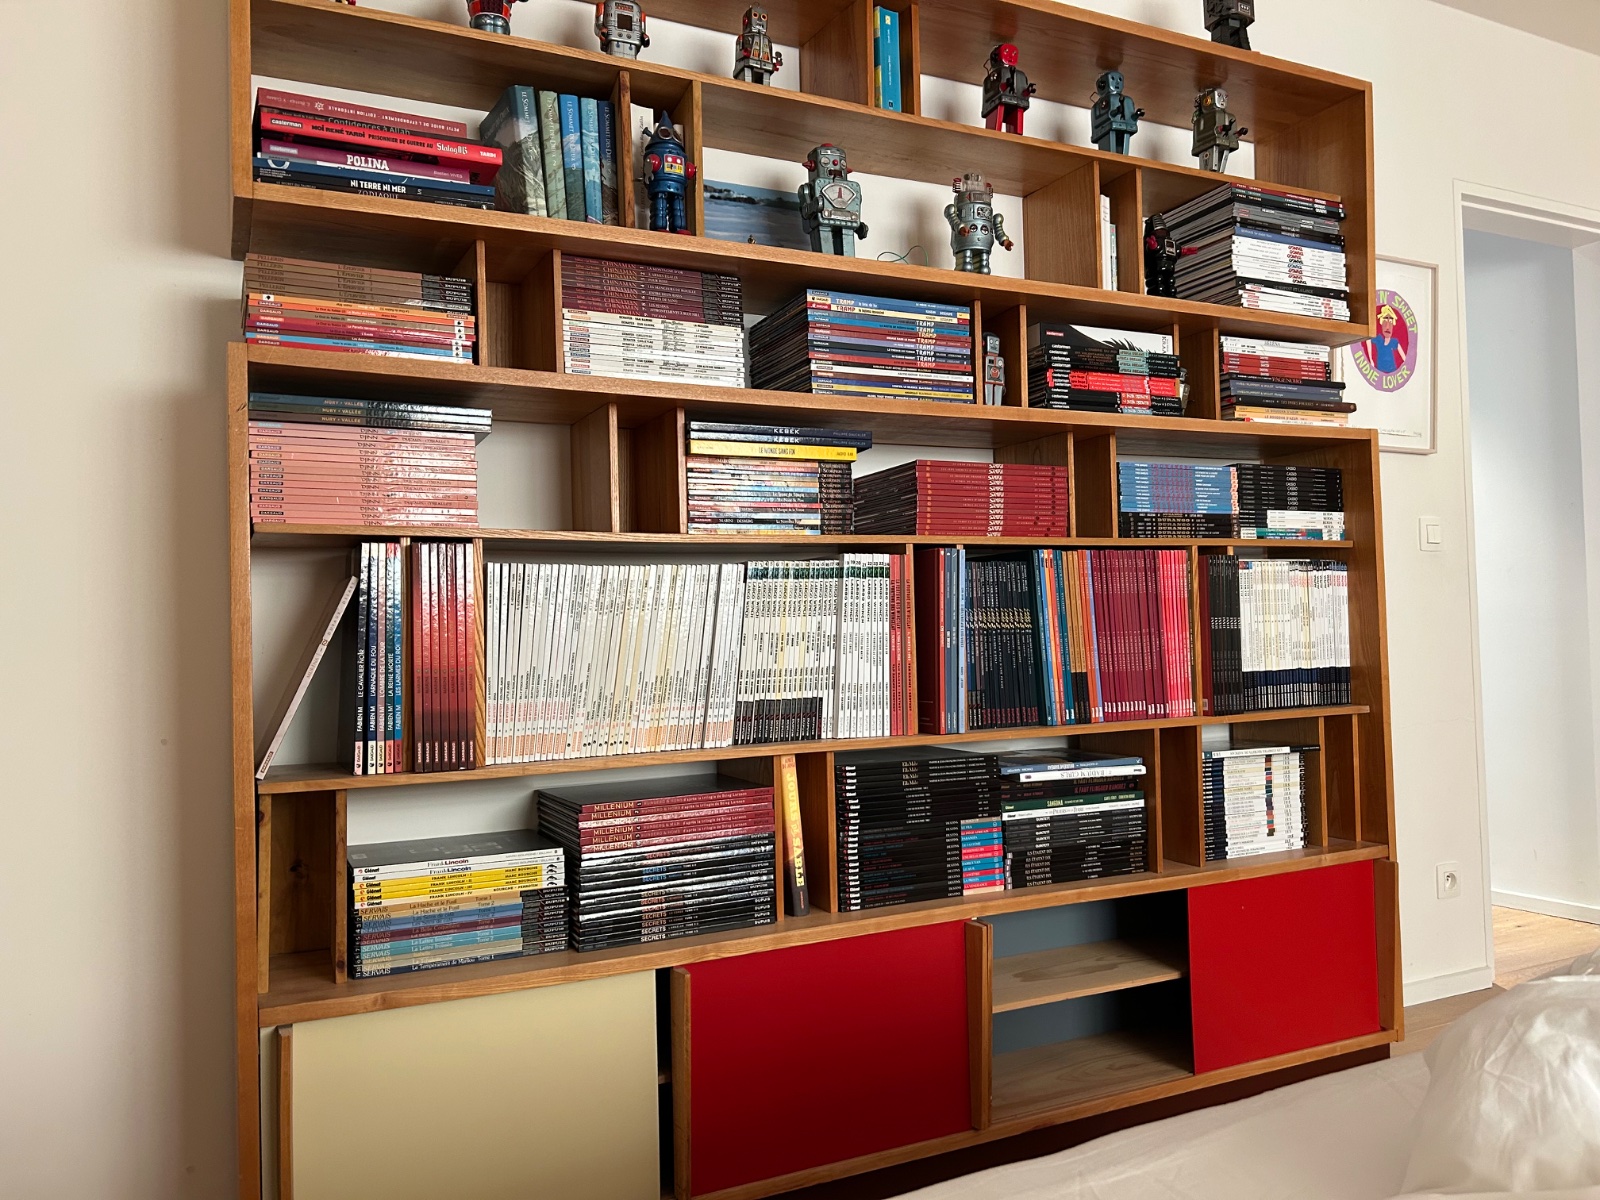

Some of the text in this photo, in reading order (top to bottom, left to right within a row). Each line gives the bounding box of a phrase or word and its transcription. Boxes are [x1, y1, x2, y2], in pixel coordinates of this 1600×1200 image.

[271, 119, 302, 128] casterman
[368, 133, 398, 143] PRISONNIER
[406, 140, 425, 148] GUERRE
[346, 154, 389, 171] POLINA
[350, 180, 406, 194] NI TERRE NI MER
[603, 291, 637, 299] CHINAMAN
[603, 297, 638, 306] CHINAMAN
[605, 302, 639, 310] CHINAMAN
[606, 308, 641, 316] CHINAMAN
[1392, 294, 1418, 334] SWEET
[1354, 350, 1380, 385] INDIE
[1382, 364, 1411, 389] LOVER
[371, 658, 376, 667] DU
[395, 654, 401, 664] DU
[380, 663, 385, 672] DE
[388, 688, 393, 697] LA
[594, 802, 634, 812] MILLENIUM
[591, 810, 632, 820] MILLENIUM
[594, 826, 634, 837] MILLENIUM
[786, 772, 805, 887] JOURS SABLE
[592, 834, 632, 844] MILLENIUM
[640, 897, 665, 905] SECRETS
[361, 906, 388, 915] SERVAIS
[364, 913, 392, 921] SERVAIS
[642, 912, 667, 920] SECRETS
[642, 920, 667, 928] SECRETS
[641, 927, 666, 935] SECRETS
[363, 932, 391, 940] SERVAIS
[640, 934, 666, 942] SECRETS
[362, 944, 391, 952] SERVAIS
[363, 950, 391, 959] SERVAIS
[363, 968, 391, 977] SERVAIS
